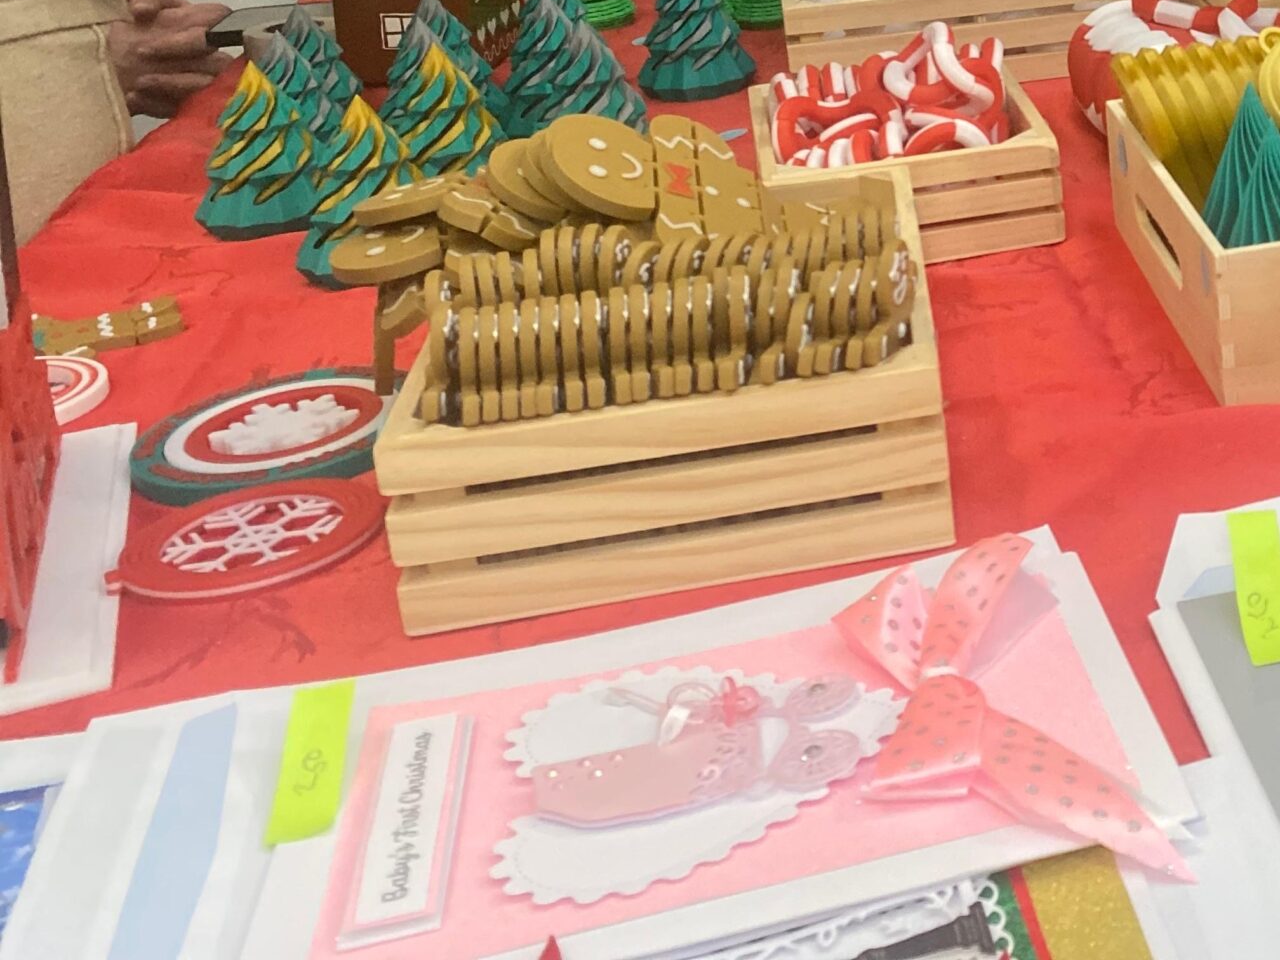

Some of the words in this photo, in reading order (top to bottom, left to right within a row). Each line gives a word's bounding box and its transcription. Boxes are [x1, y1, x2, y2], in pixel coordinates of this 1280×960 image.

[396, 730, 435, 804] Christmas
[390, 804, 422, 842] First
[380, 841, 421, 903] Baby's
